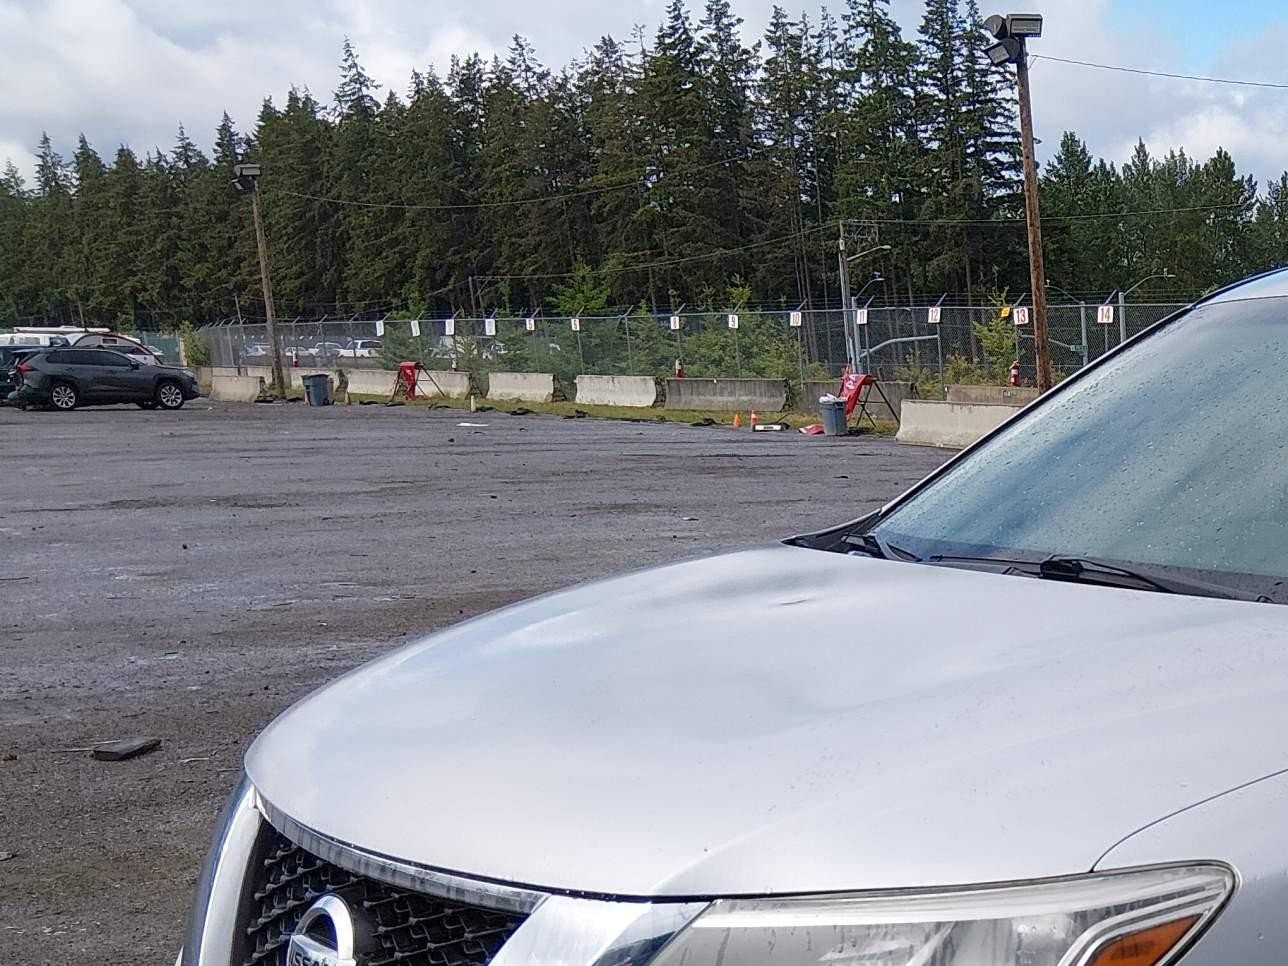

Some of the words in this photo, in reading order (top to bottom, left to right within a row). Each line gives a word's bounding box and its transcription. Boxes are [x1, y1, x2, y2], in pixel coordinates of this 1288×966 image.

[792, 313, 800, 325] 10
[930, 308, 939, 322] 12
[1016, 308, 1026, 324] 13
[1101, 307, 1111, 322] 14
